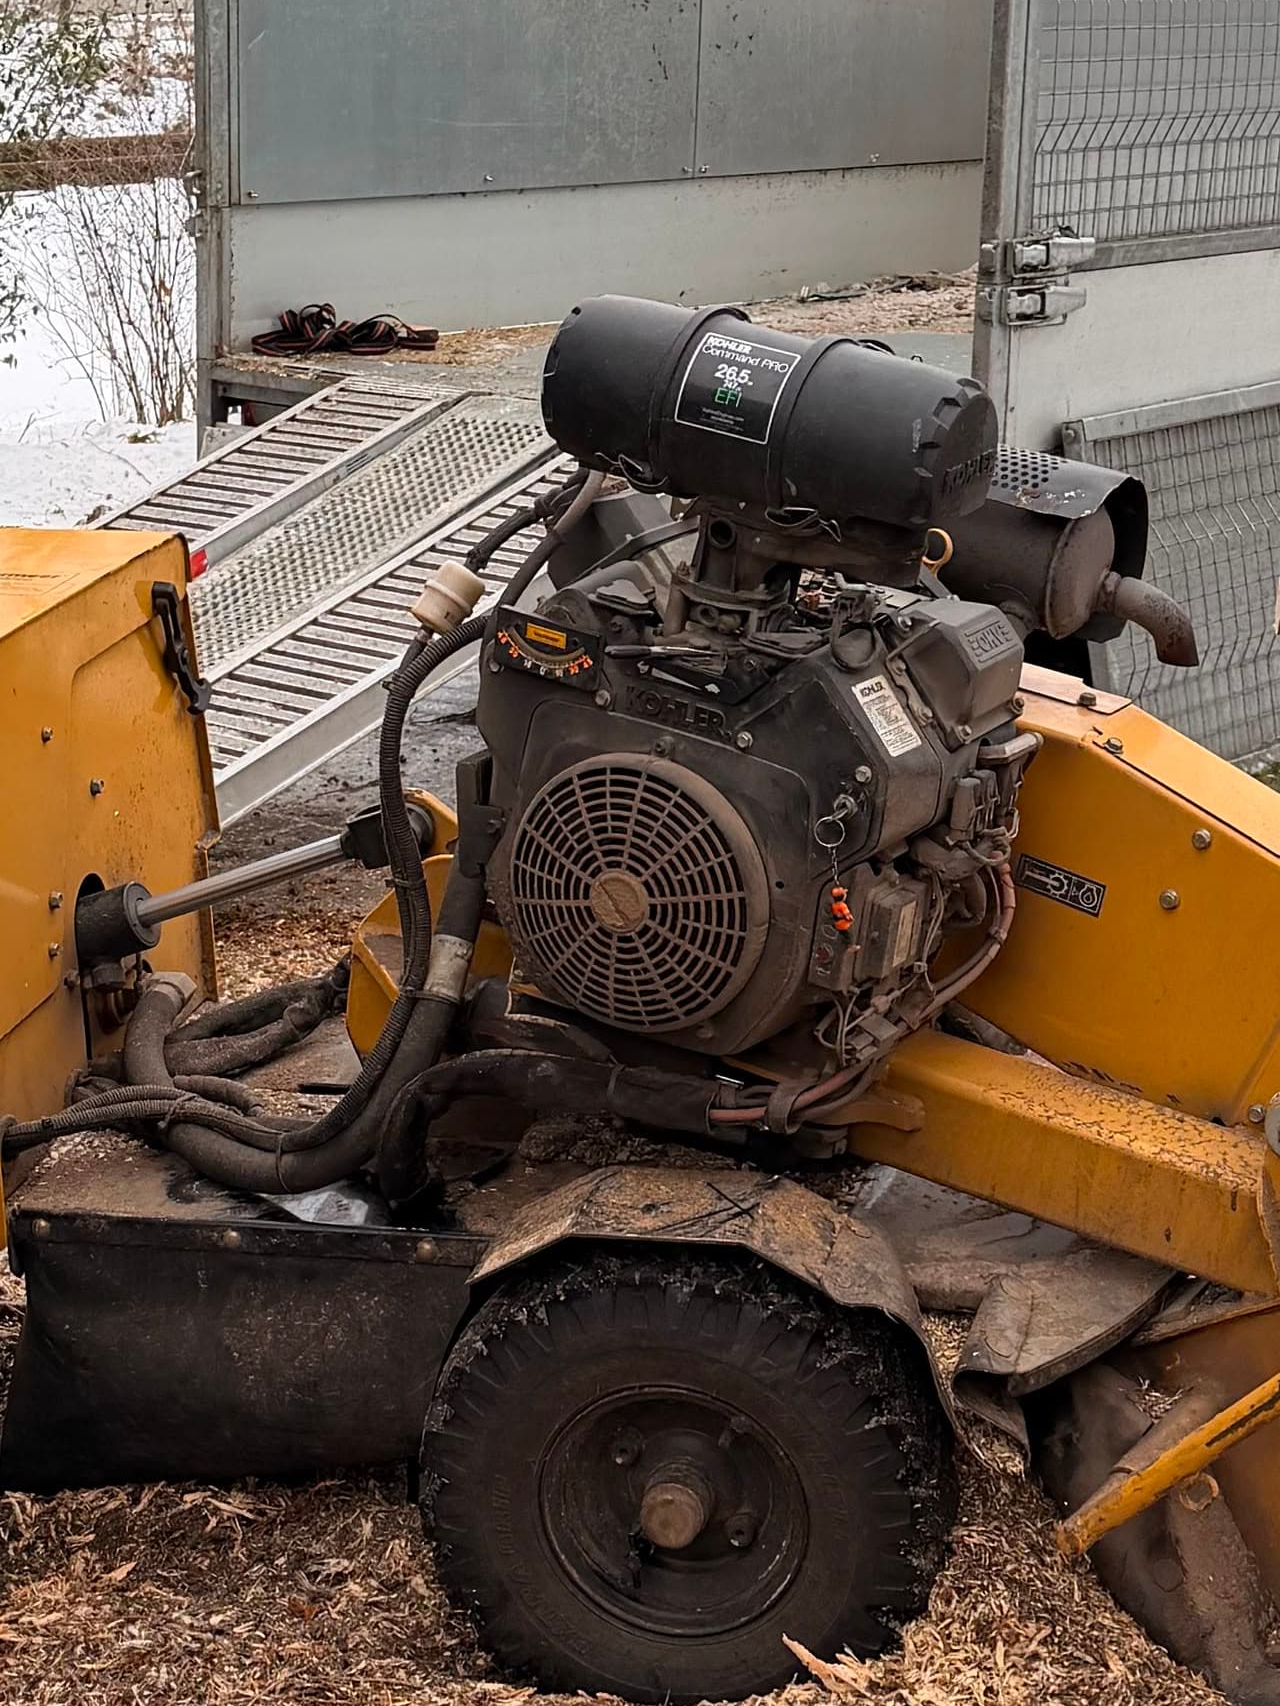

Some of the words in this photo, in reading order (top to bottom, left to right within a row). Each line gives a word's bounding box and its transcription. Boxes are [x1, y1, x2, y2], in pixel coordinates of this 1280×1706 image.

[707, 336, 752, 354] KOHLER
[703, 345, 761, 366] Command
[761, 358, 789, 373] PRO
[714, 387, 742, 408] EFI
